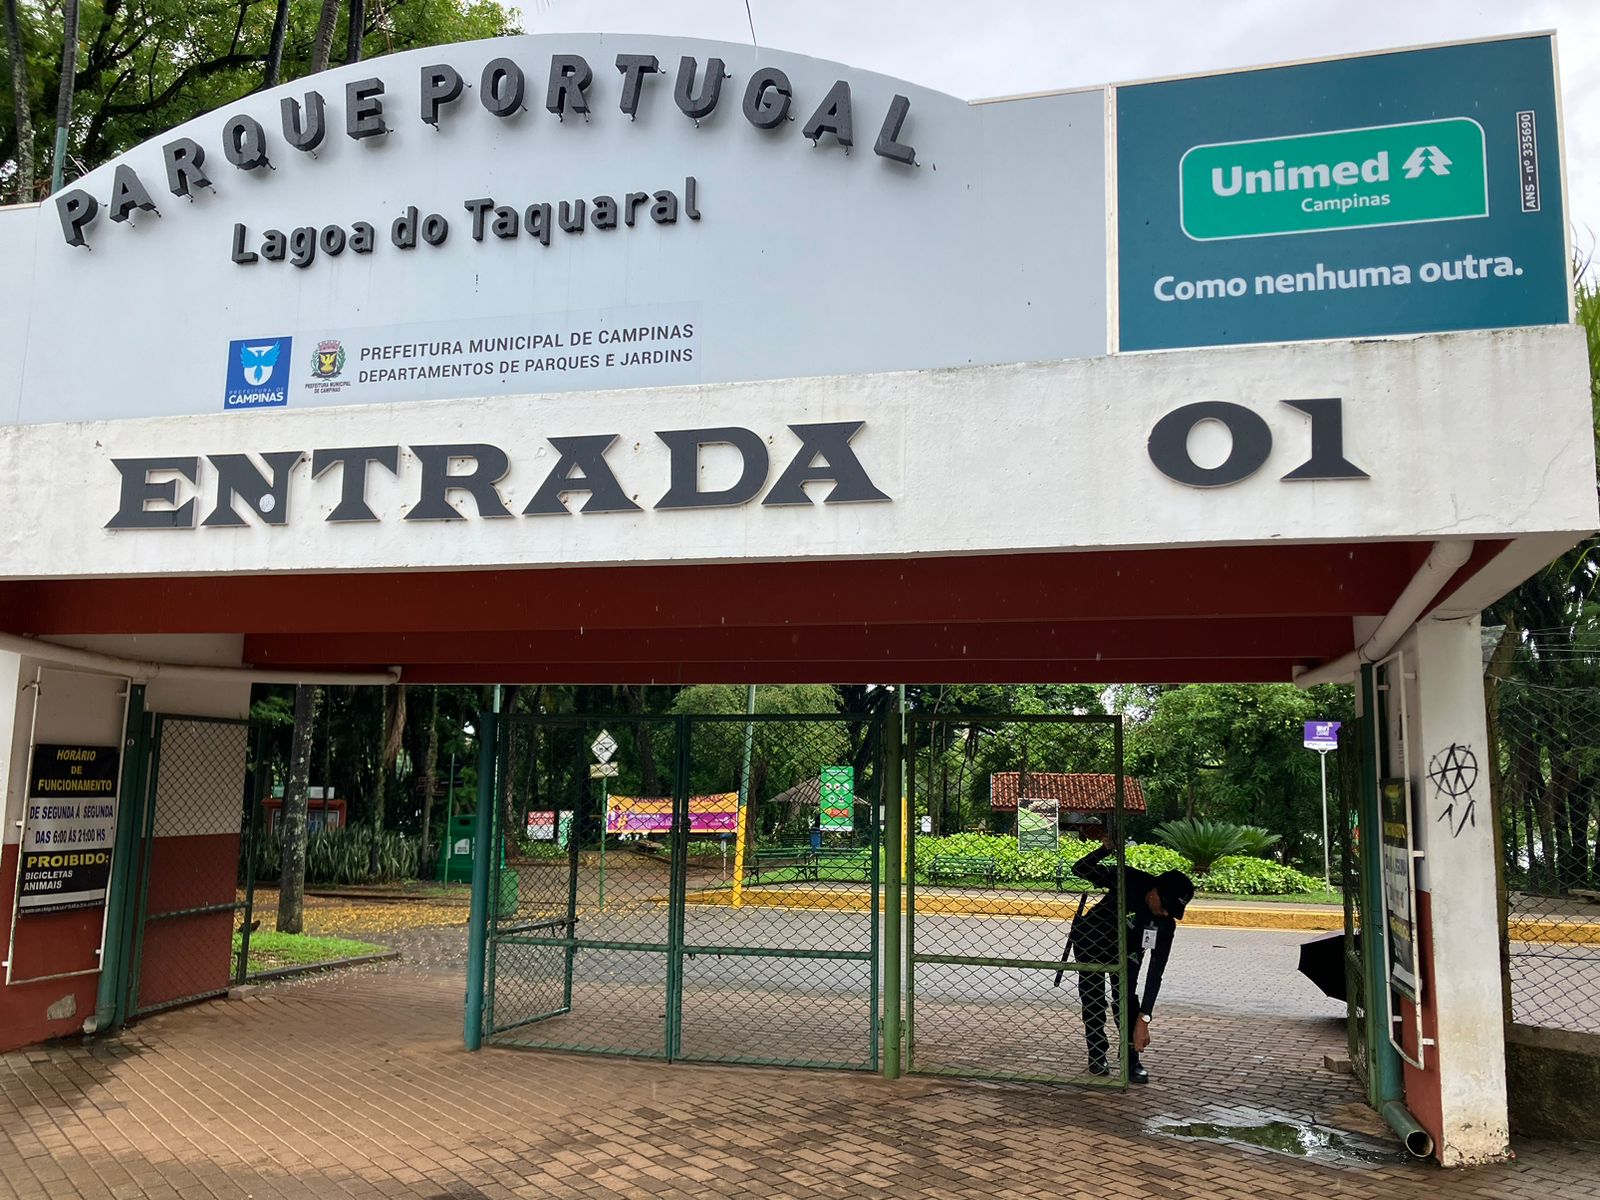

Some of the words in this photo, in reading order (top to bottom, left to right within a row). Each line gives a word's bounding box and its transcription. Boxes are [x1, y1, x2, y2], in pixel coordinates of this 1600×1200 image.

[1520, 114, 1533, 157] 335690
[56, 77, 387, 247] PARQUE
[420, 54, 917, 165] PORTUGAL
[1211, 151, 1389, 197] Unimed
[1301, 193, 1391, 214] Campinas
[1525, 183, 1536, 208] ANS
[232, 222, 375, 268] Lagoa
[391, 205, 448, 249] do
[464, 177, 701, 245] Taquaral
[1153, 275, 1247, 301] Como
[1255, 263, 1411, 295] nenhuma
[1420, 254, 1523, 282] outra.
[360, 341, 463, 361] PREFEITURA
[469, 334, 564, 353] MUNICIPAL
[570, 331, 592, 346] DE
[598, 324, 694, 344] CAMPINAS
[359, 362, 494, 383] DEPARTAMENTOS
[499, 360, 519, 374] DE
[525, 354, 600, 372] PARQUES
[605, 353, 615, 367] E
[620, 348, 693, 366] JARDINS
[228, 391, 284, 405] CAMPINAS
[105, 421, 892, 530] ENTRADA
[1147, 397, 1371, 489] 01
[57, 748, 96, 762] HORÁRIO
[71, 766, 82, 775] DE
[38, 779, 112, 791] FUNCIONAMENTO
[30, 806, 41, 819] DE
[42, 805, 74, 819] SEGUNDA
[83, 805, 113, 818] SEGUNDA
[35, 831, 51, 844] DAS
[53, 830, 67, 843] 6:00
[78, 829, 95, 842] 21:00
[96, 829, 105, 841] HS
[27, 852, 109, 868] PROIBIDO:
[24, 880, 62, 891] ANIMAIS
[25, 870, 73, 880] BICICLETAS
